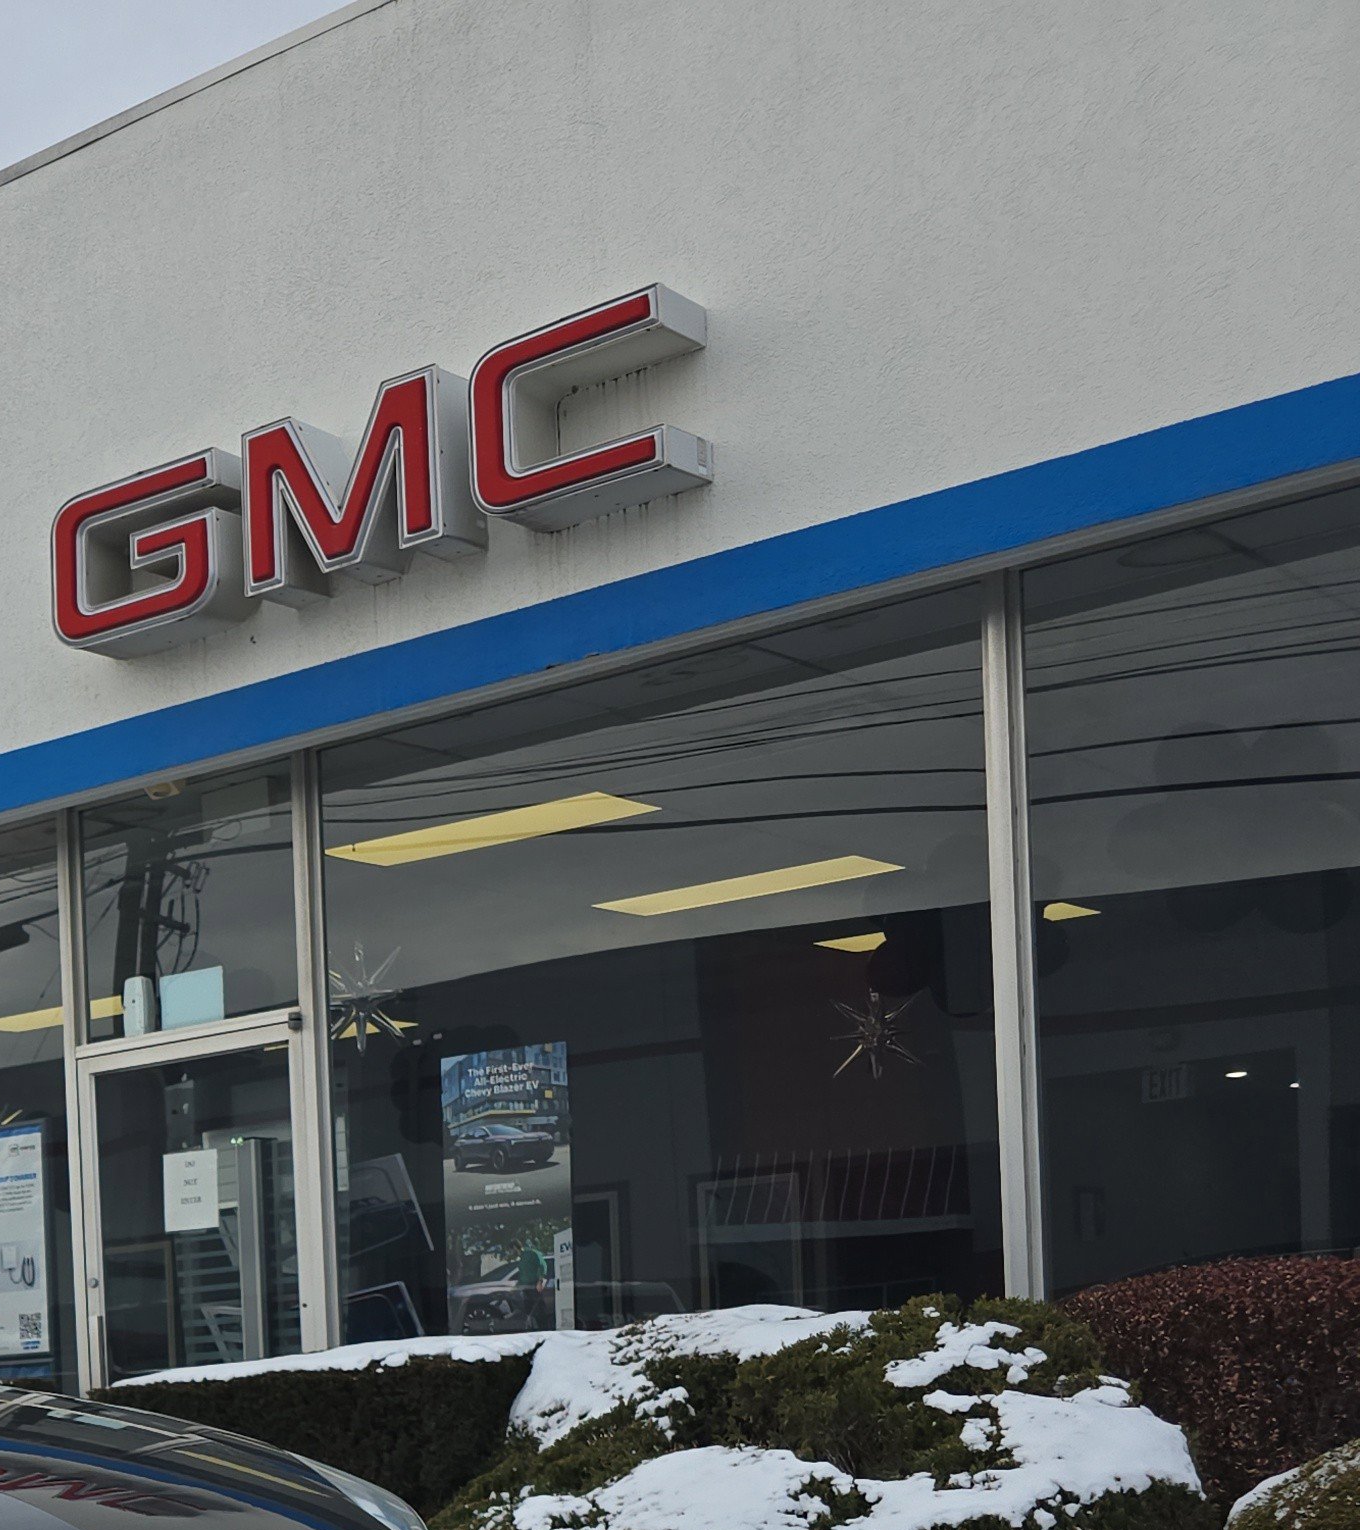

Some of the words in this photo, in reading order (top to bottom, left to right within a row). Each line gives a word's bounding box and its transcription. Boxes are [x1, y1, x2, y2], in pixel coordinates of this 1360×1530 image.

[50, 282, 705, 656] GMC
[467, 1068, 485, 1077] The
[486, 1062, 534, 1075] First-Ever
[474, 1072, 528, 1086] All-Electric
[464, 1087, 492, 1099] Chevy
[493, 1082, 524, 1094] Blazer
[525, 1080, 540, 1091] EV
[1149, 1070, 1184, 1098] EXIT
